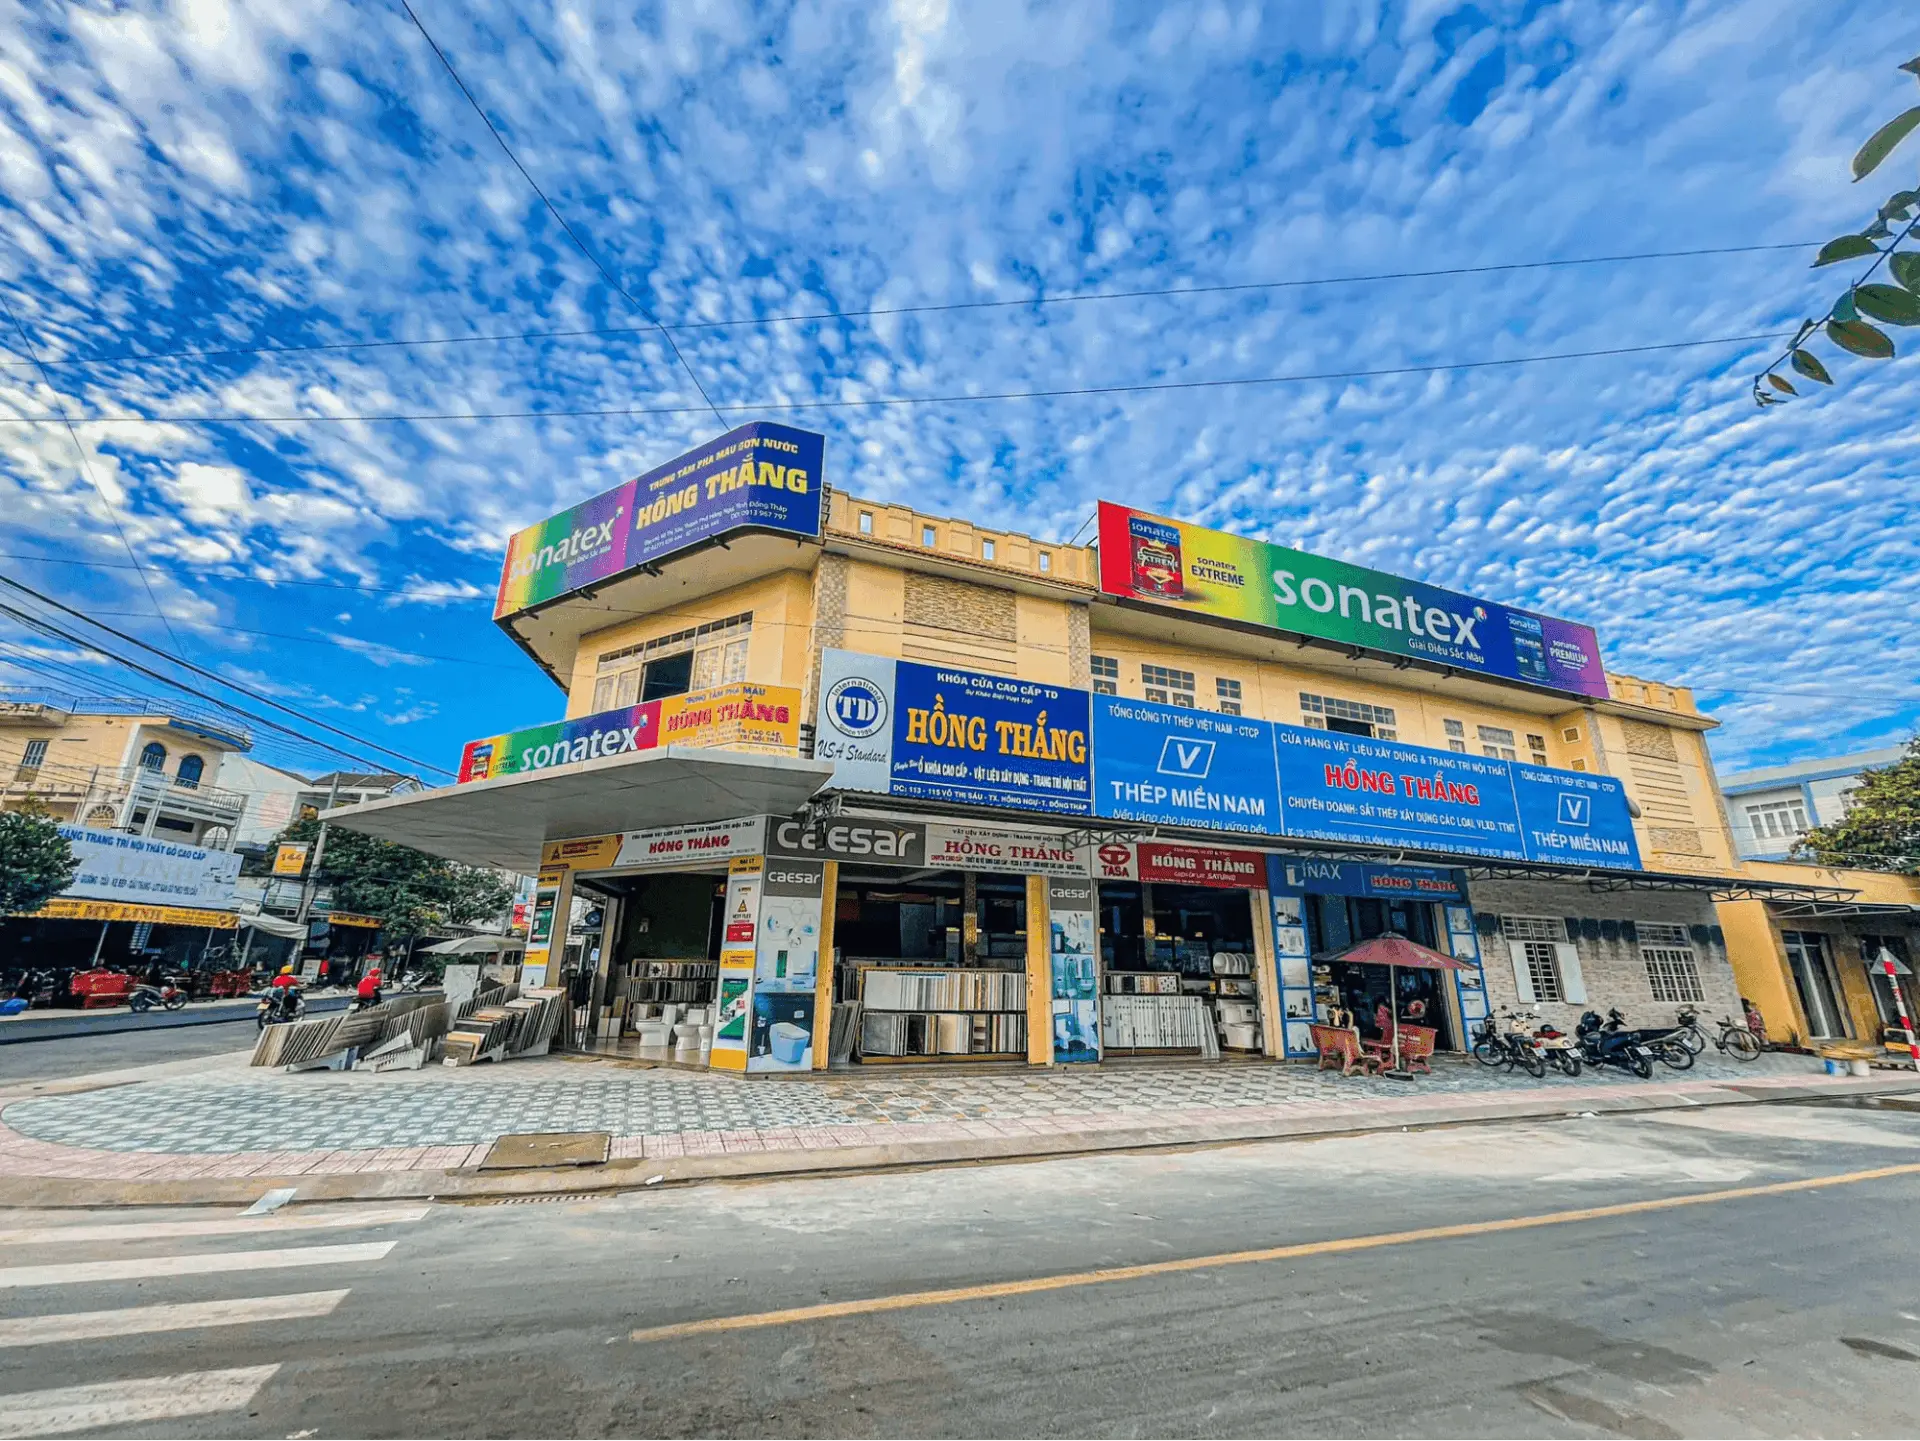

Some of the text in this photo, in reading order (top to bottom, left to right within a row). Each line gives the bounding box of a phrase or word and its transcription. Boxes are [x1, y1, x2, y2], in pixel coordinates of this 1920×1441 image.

[697, 455, 714, 470] PHA
[763, 438, 799, 454] NƯỚC
[705, 452, 808, 500] THẮNG
[1131, 522, 1179, 541] sonatex
[508, 517, 615, 583] sonatex
[1191, 565, 1244, 586] EXTREME
[1197, 557, 1237, 571] sonatex
[1272, 569, 1481, 650] sonatex
[1409, 638, 1485, 665] Giai Điệu Sắc Màu
[1549, 647, 1589, 664] PREMIUM
[832, 680, 884, 704] International
[937, 673, 1059, 700] KHÓA CỬA CAO CẤP TD
[838, 695, 876, 722] TD
[1108, 703, 1260, 739] TỔNG CÔNG TY THÉP VIỆT NAM CTCP
[906, 693, 1086, 764] HỒNG THẮNG
[519, 725, 640, 772] sonatex
[846, 745, 888, 764] Standard
[1176, 743, 1202, 770] V
[1280, 729, 1301, 746] CỬA
[1304, 735, 1332, 750] HÀNG
[1333, 740, 1351, 754] VẬT
[1352, 743, 1373, 758] LIỆU
[1375, 746, 1391, 759] XÂY
[1393, 749, 1419, 765] DỰNG
[1428, 756, 1456, 769] TRANG
[1457, 760, 1471, 772] TRÍ
[1472, 763, 1486, 775] NỘI
[1487, 764, 1507, 777] THẤT
[942, 764, 955, 777] CAO
[1324, 757, 1480, 807] HỒNG THẮNG
[1110, 780, 1266, 817] THÉP MIỀN NAM
[1288, 795, 1325, 811] CHUYÊN
[1327, 800, 1359, 815] DOANH:
[1359, 802, 1375, 817] SẮT
[1377, 806, 1399, 820] THÉP
[1400, 809, 1415, 822] XÂY
[1416, 812, 1439, 828] DỰNG
[1439, 814, 1456, 827] CÁC
[1566, 799, 1582, 820] V
[85, 832, 114, 847] TRANG
[116, 836, 129, 849] TRÍ
[145, 841, 166, 855] THẤT
[944, 835, 1075, 863] HỒNG THẮNG
[1531, 829, 1568, 849] THÉP
[1568, 832, 1603, 853] MIỀN
[1602, 839, 1630, 856] NAM
[768, 871, 821, 885] caesar
[1101, 864, 1130, 878] TASA
[1303, 863, 1343, 881] INAX
[1050, 888, 1091, 899] caesar
